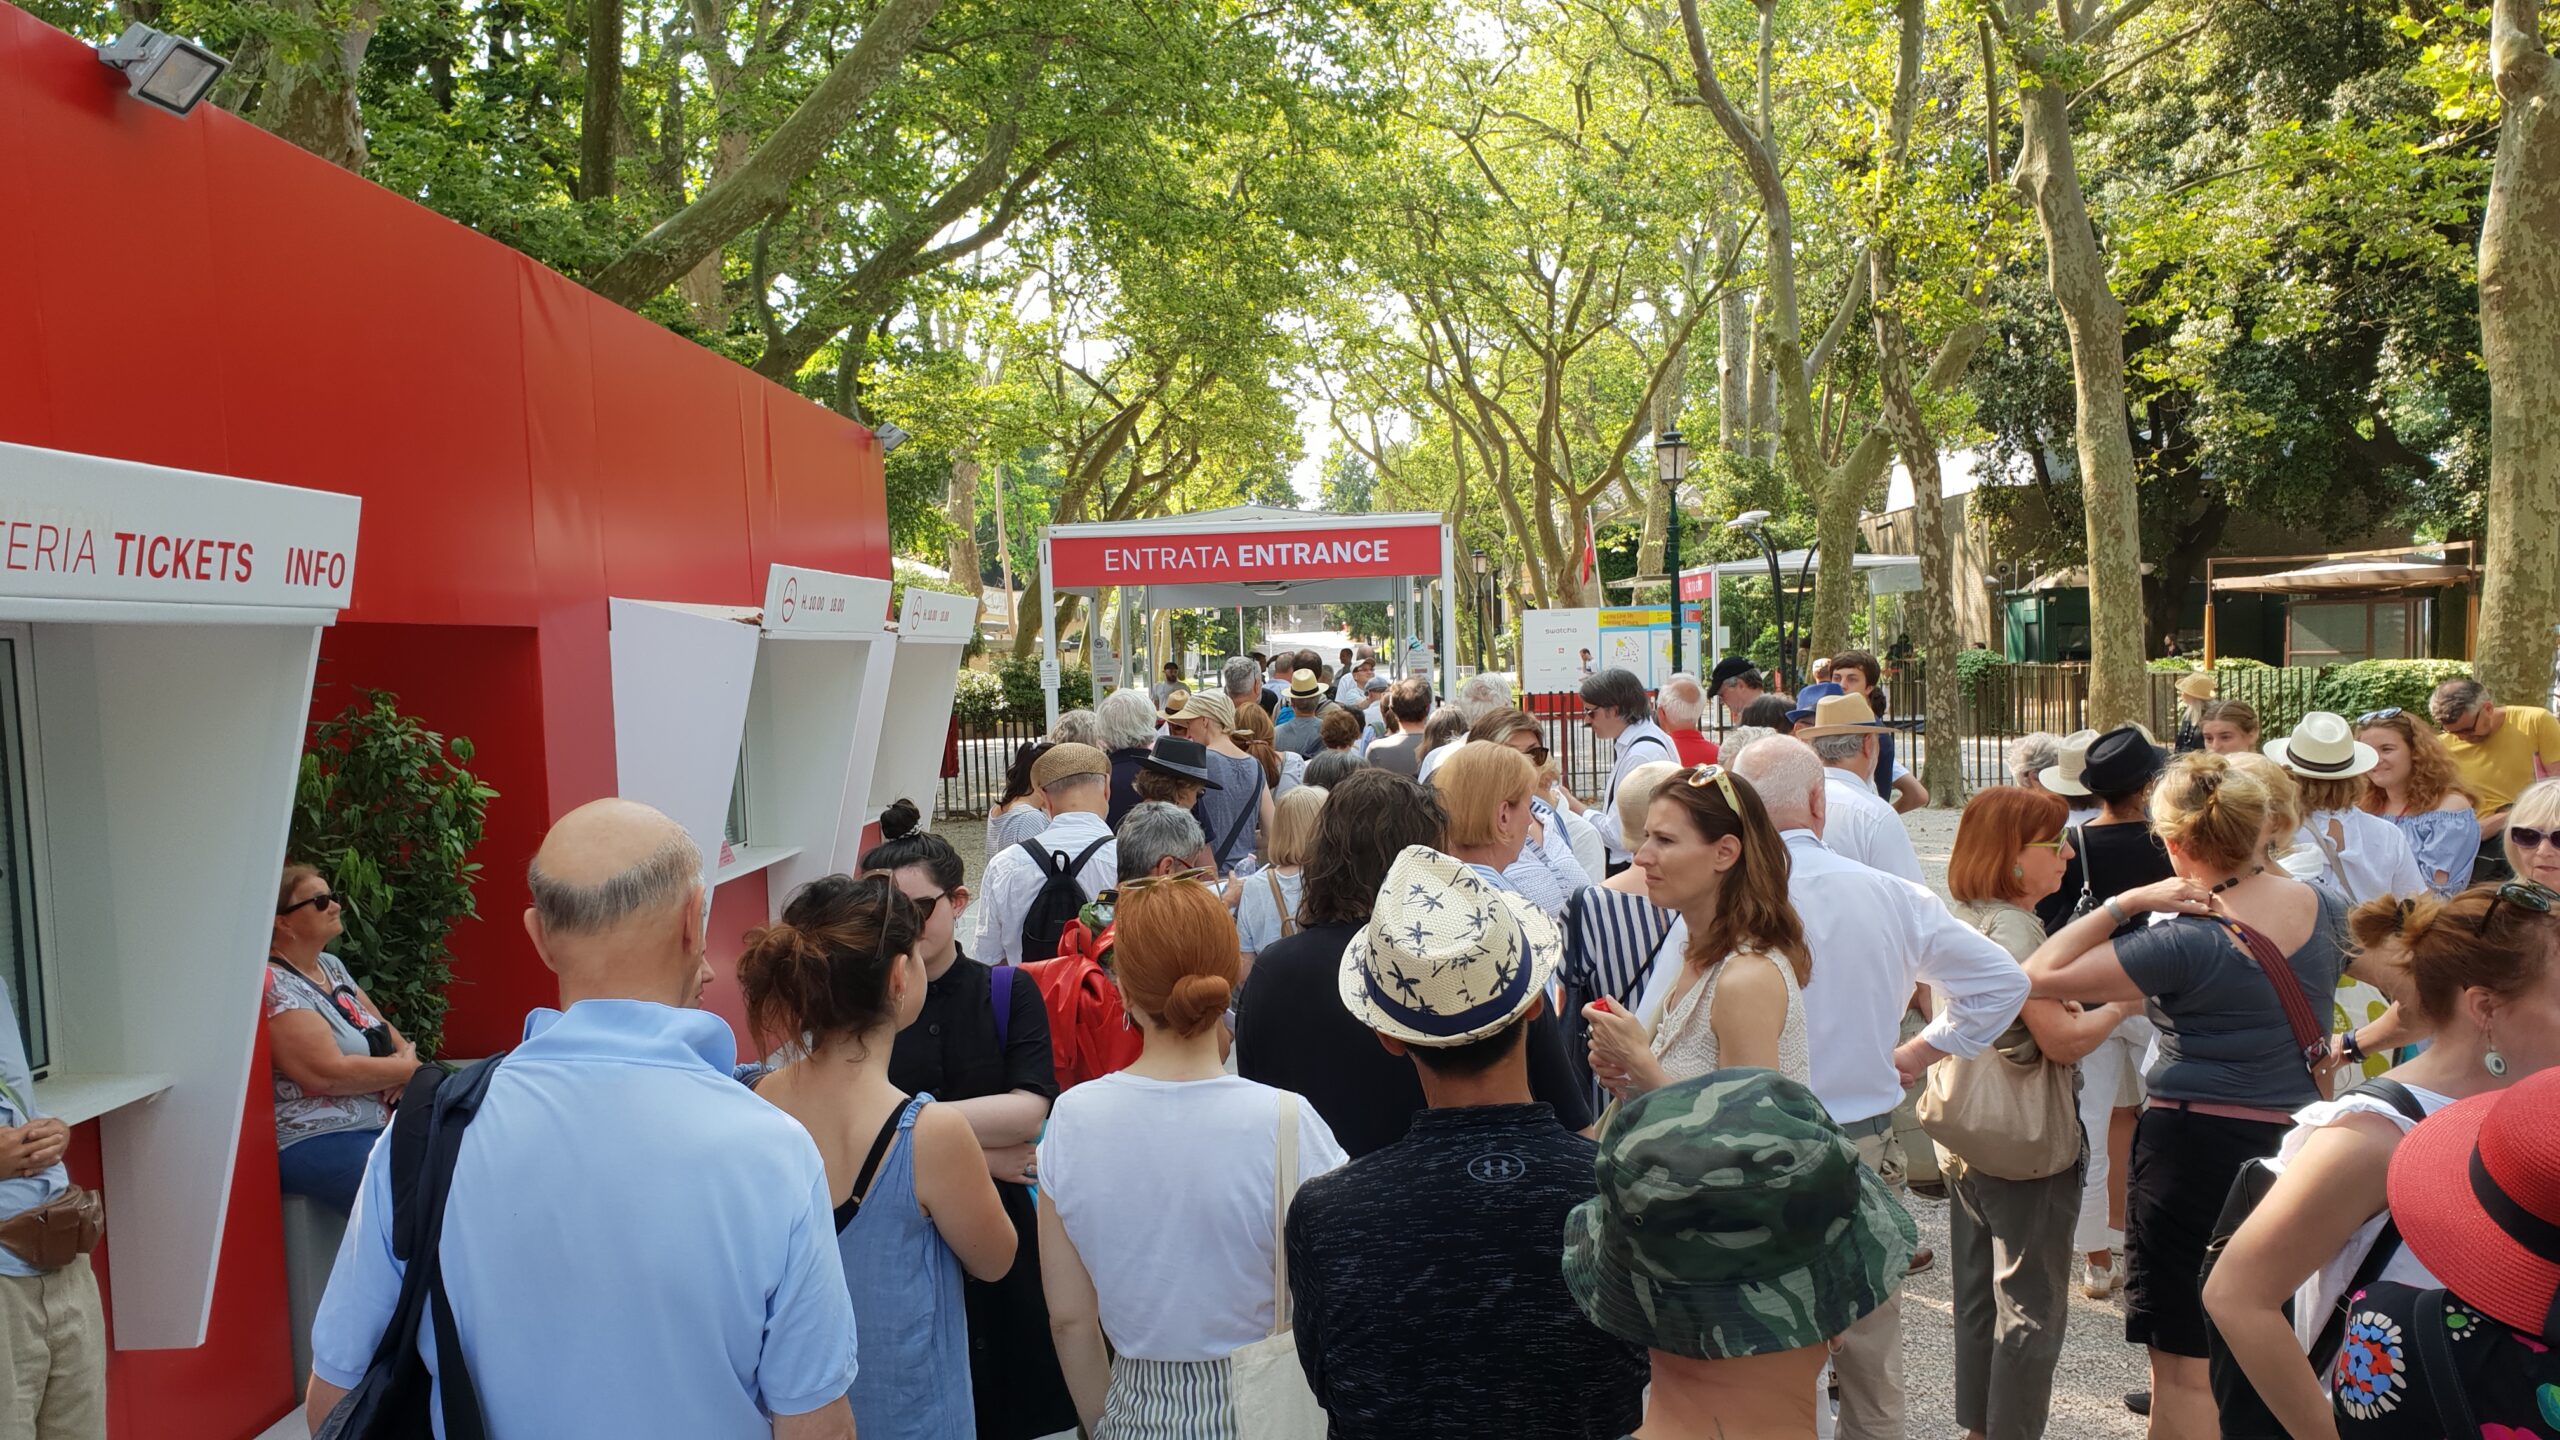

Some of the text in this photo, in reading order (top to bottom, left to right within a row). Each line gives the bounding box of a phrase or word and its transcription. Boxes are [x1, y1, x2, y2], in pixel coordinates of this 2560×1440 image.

[0, 520, 346, 589] ERIA TICKETS INFO
[1104, 539, 1389, 571] ENTRATA ENTRANCE
